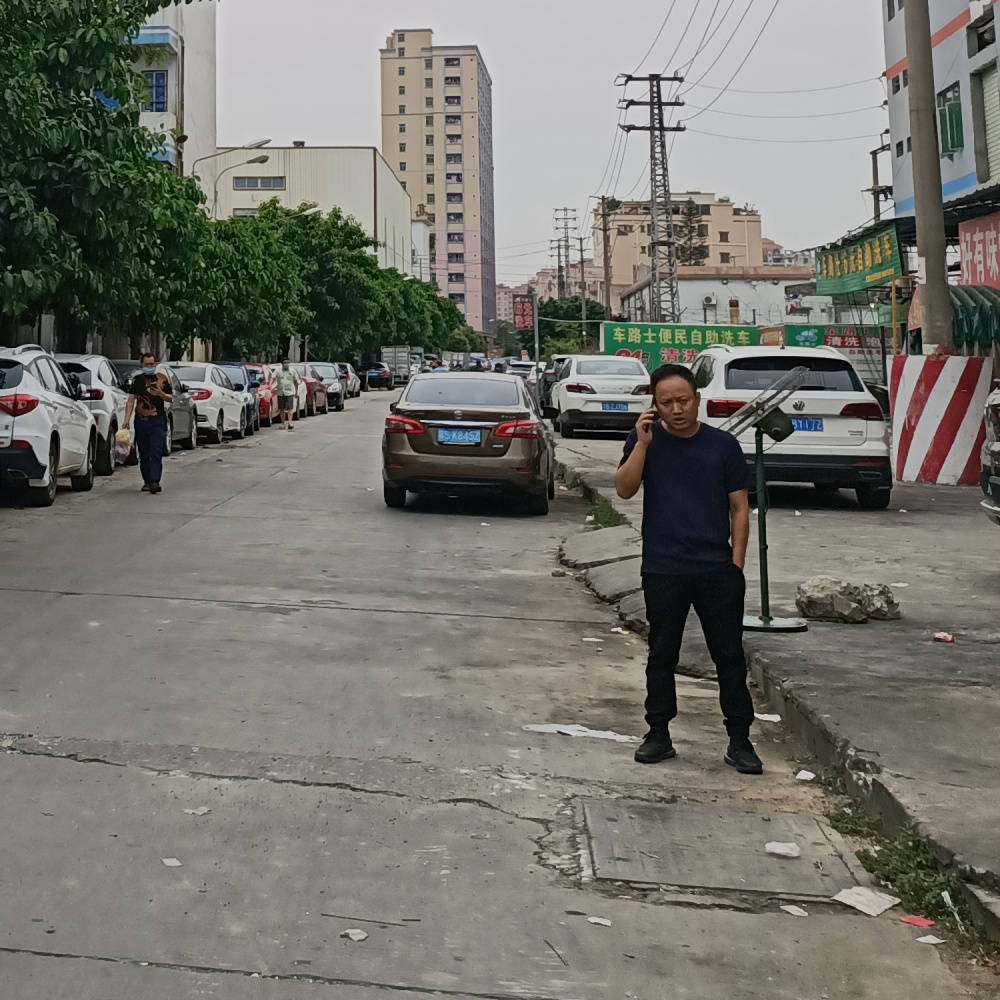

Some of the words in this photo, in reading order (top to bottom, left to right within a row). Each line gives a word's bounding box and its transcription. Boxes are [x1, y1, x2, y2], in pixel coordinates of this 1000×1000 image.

[961, 223, 1000, 285] 好有味
[613, 327, 750, 345] 车路士便民自助洗车
